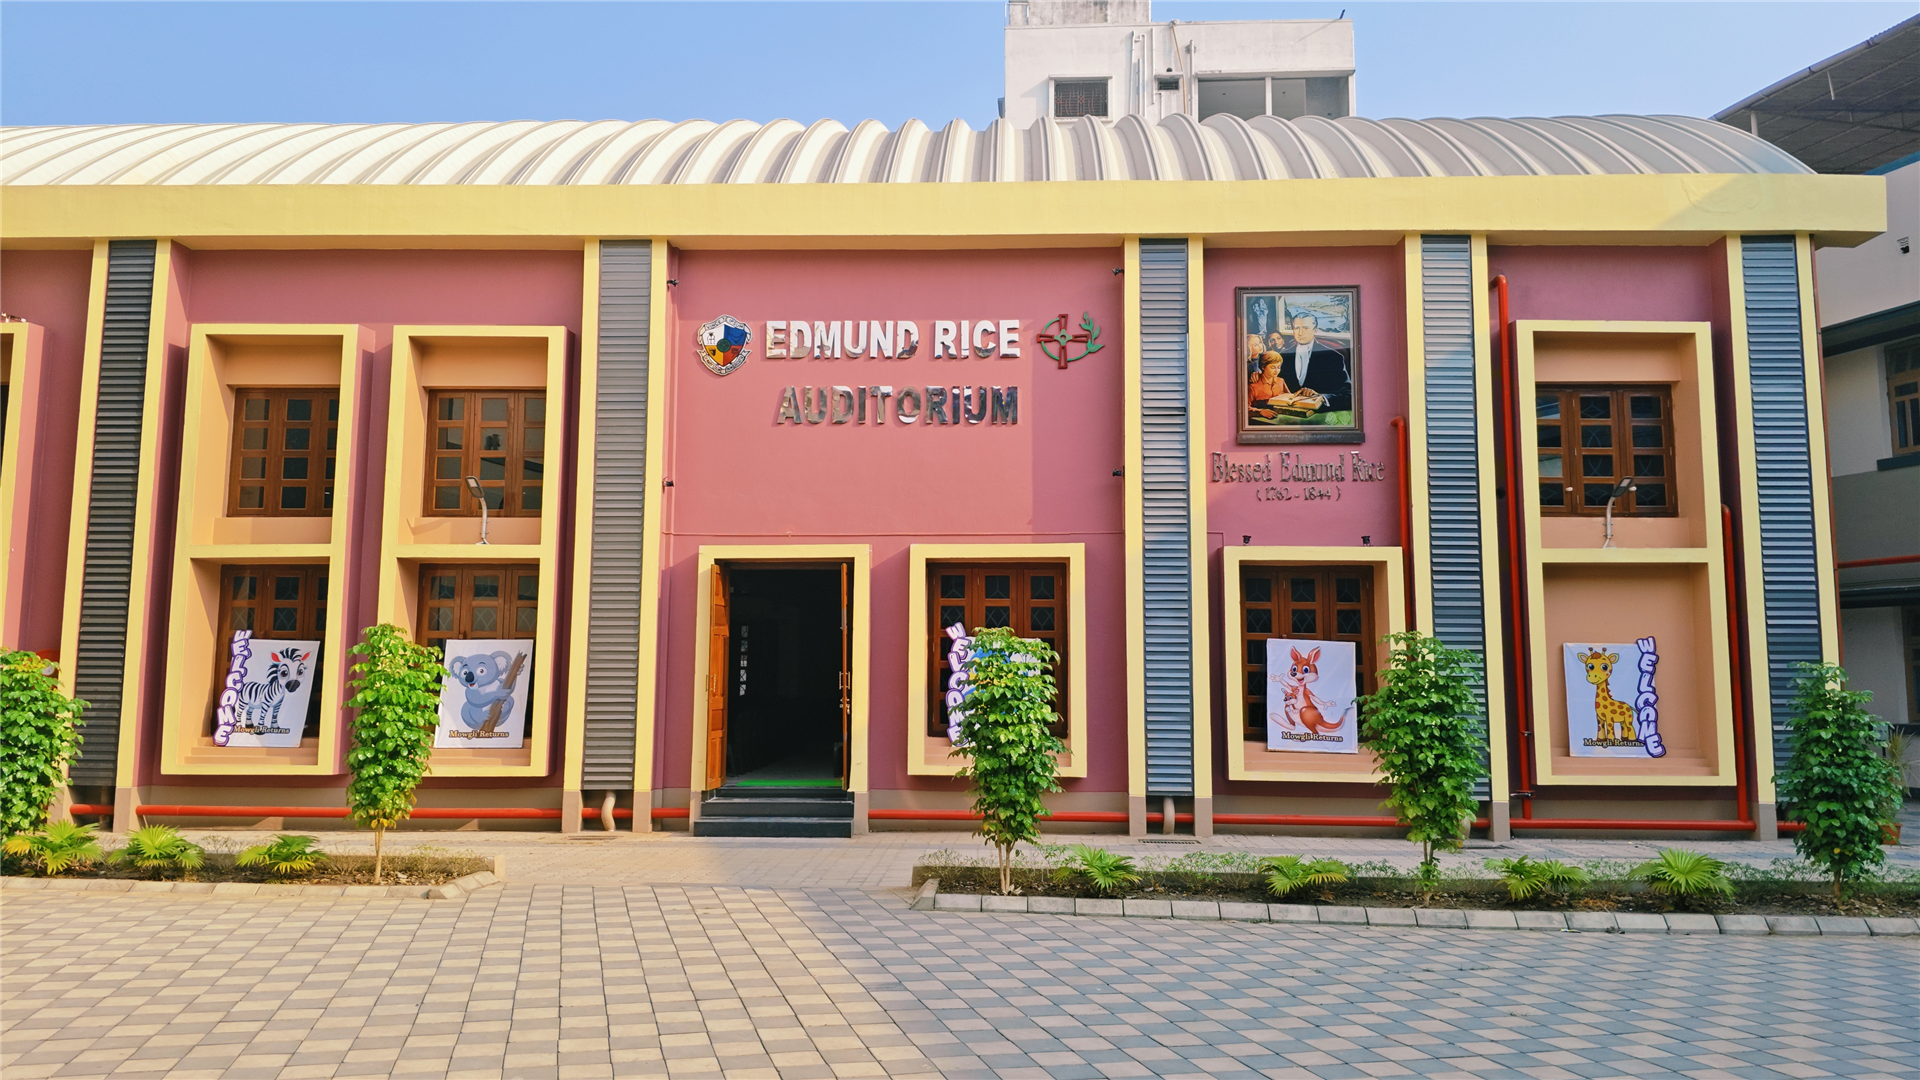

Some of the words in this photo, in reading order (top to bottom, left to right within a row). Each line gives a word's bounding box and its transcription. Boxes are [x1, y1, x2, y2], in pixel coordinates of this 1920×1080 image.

[766, 320, 920, 359] EDMUND
[934, 319, 1020, 359] RICE
[777, 386, 1019, 425] AUDITORIUM
[1212, 451, 1272, 483] Blessed
[1280, 451, 1346, 483] Edmund
[1351, 451, 1385, 483] Rice
[213, 629, 253, 746] WELCOME
[1635, 636, 1666, 758] WELCOME
[234, 725, 260, 735] Mowgli
[261, 725, 290, 734] Returns
[449, 730, 478, 740] Mowgli
[479, 730, 509, 738] Returns
[1281, 731, 1312, 742] Mowgli
[1313, 733, 1343, 742] Returns
[1583, 738, 1613, 748] Mowgli
